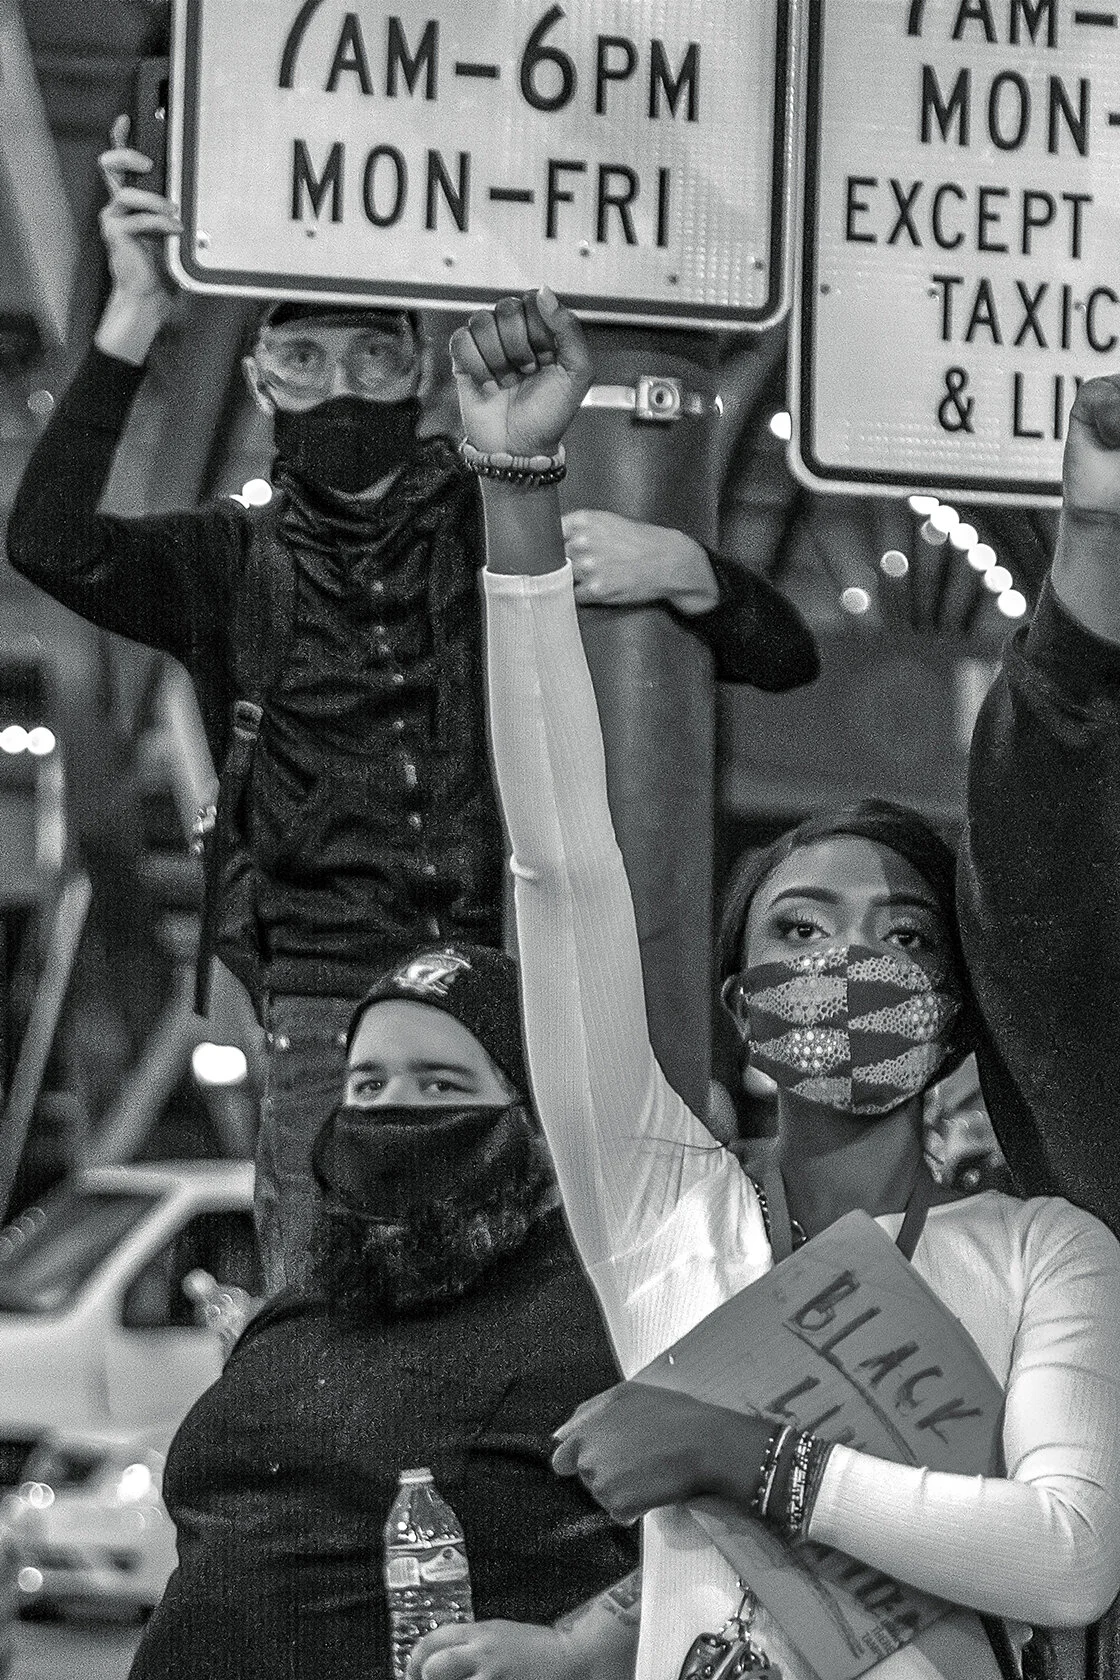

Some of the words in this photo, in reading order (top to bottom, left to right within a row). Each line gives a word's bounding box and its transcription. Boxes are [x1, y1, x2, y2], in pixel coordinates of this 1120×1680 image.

[844, 175, 1093, 260] EXCEPT
[937, 366, 975, 434] &
[787, 1269, 985, 1448] BLACK
